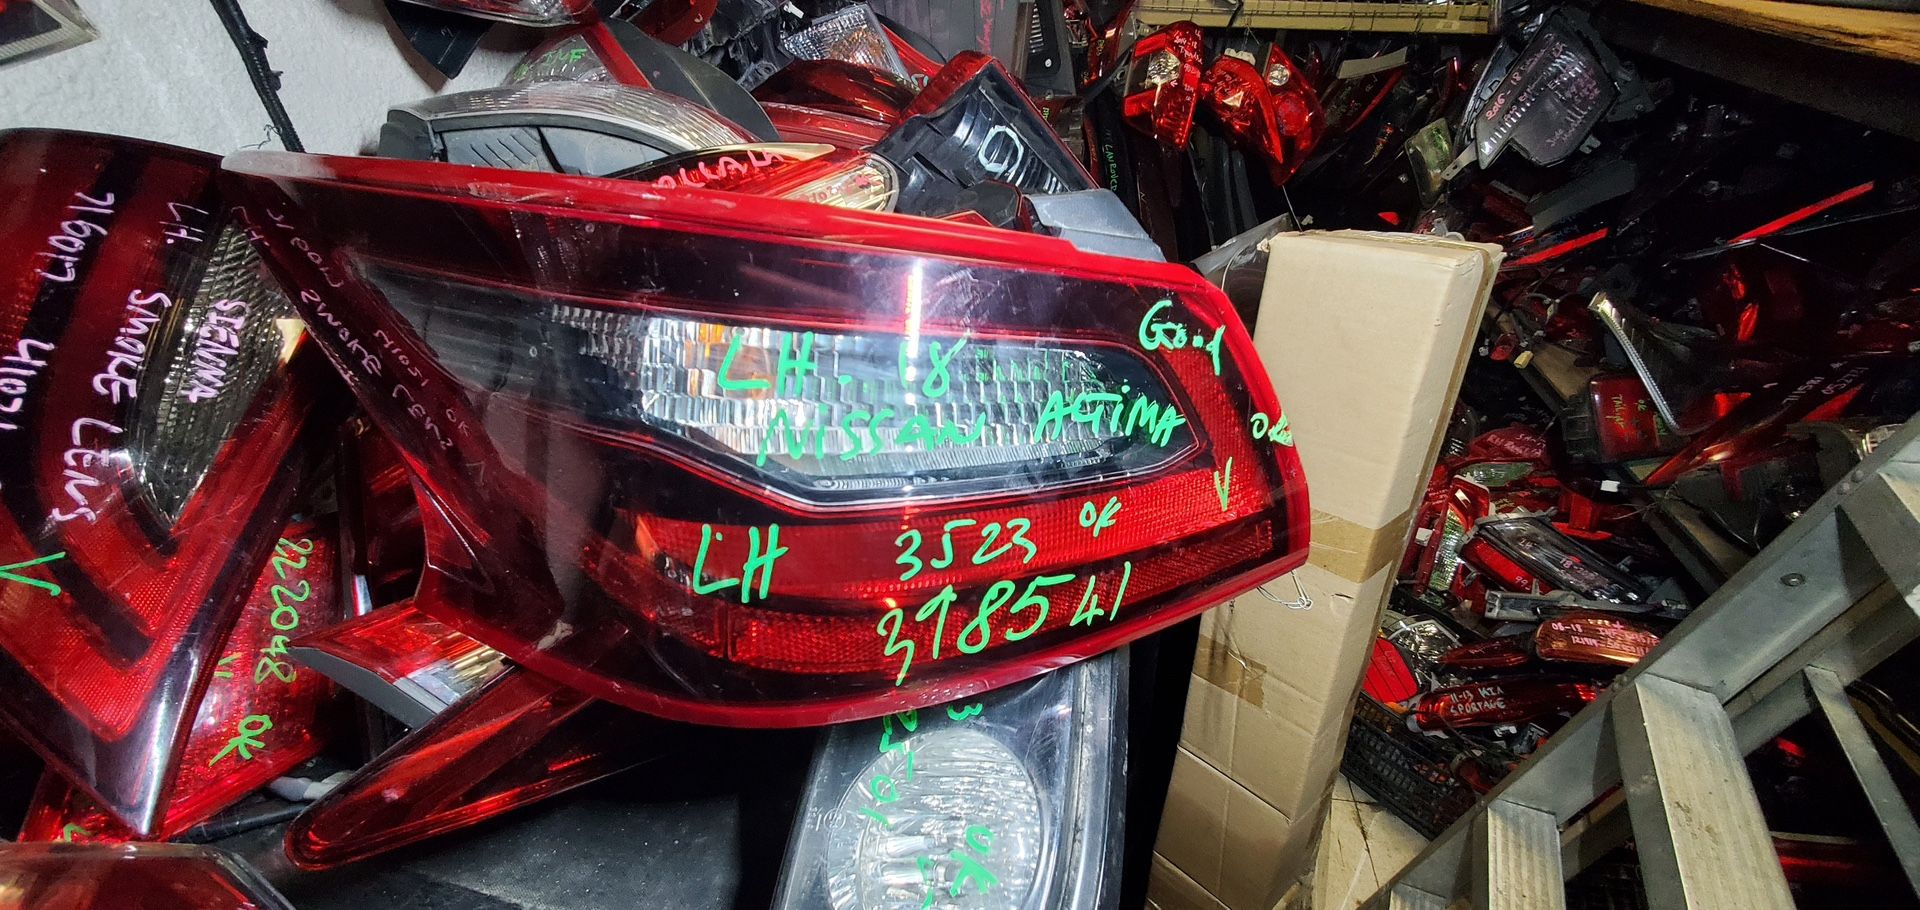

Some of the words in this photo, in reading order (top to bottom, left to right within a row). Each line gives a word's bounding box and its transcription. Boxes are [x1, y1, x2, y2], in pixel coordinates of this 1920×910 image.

[92, 289, 172, 404] SMOKE
[51, 417, 123, 523] LENS
[895, 517, 1038, 582] 3523
[952, 832, 998, 896] OK
